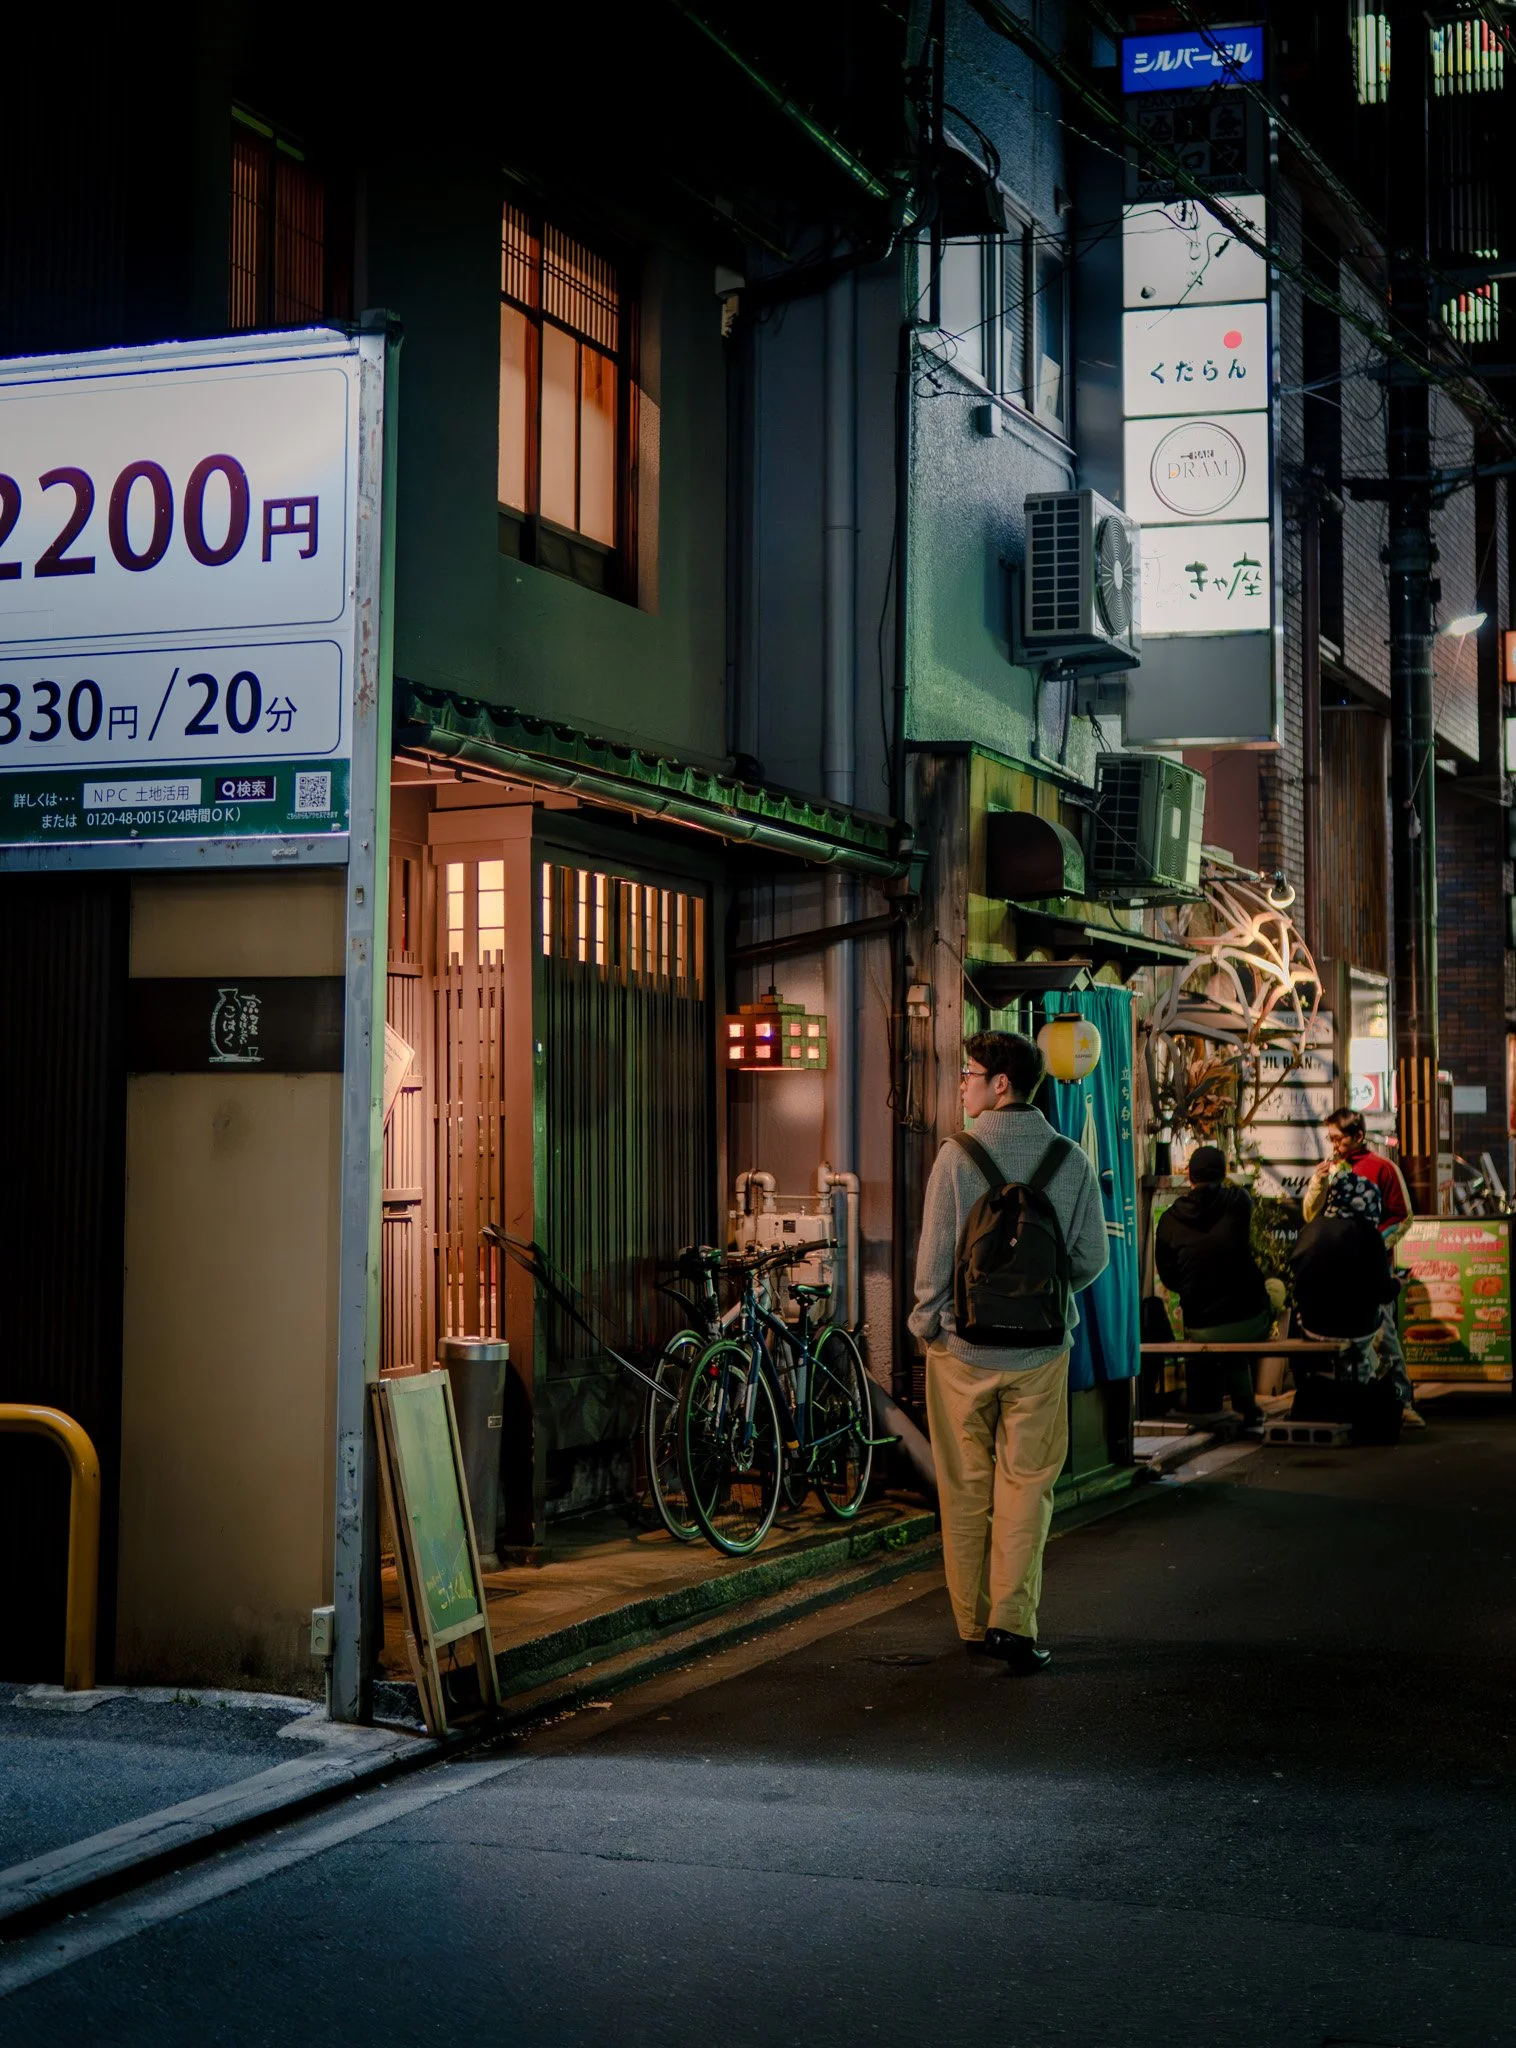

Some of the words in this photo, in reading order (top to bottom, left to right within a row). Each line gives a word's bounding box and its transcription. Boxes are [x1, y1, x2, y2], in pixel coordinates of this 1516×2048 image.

[1133, 43, 1253, 74] シルバービル
[1151, 358, 1246, 384] くだらん
[1168, 460, 1229, 479] DRAM
[93, 788, 128, 803] NPC
[135, 786, 189, 802] 土地活用
[41, 813, 77, 828] または
[223, 1005, 236, 1047] こはく
